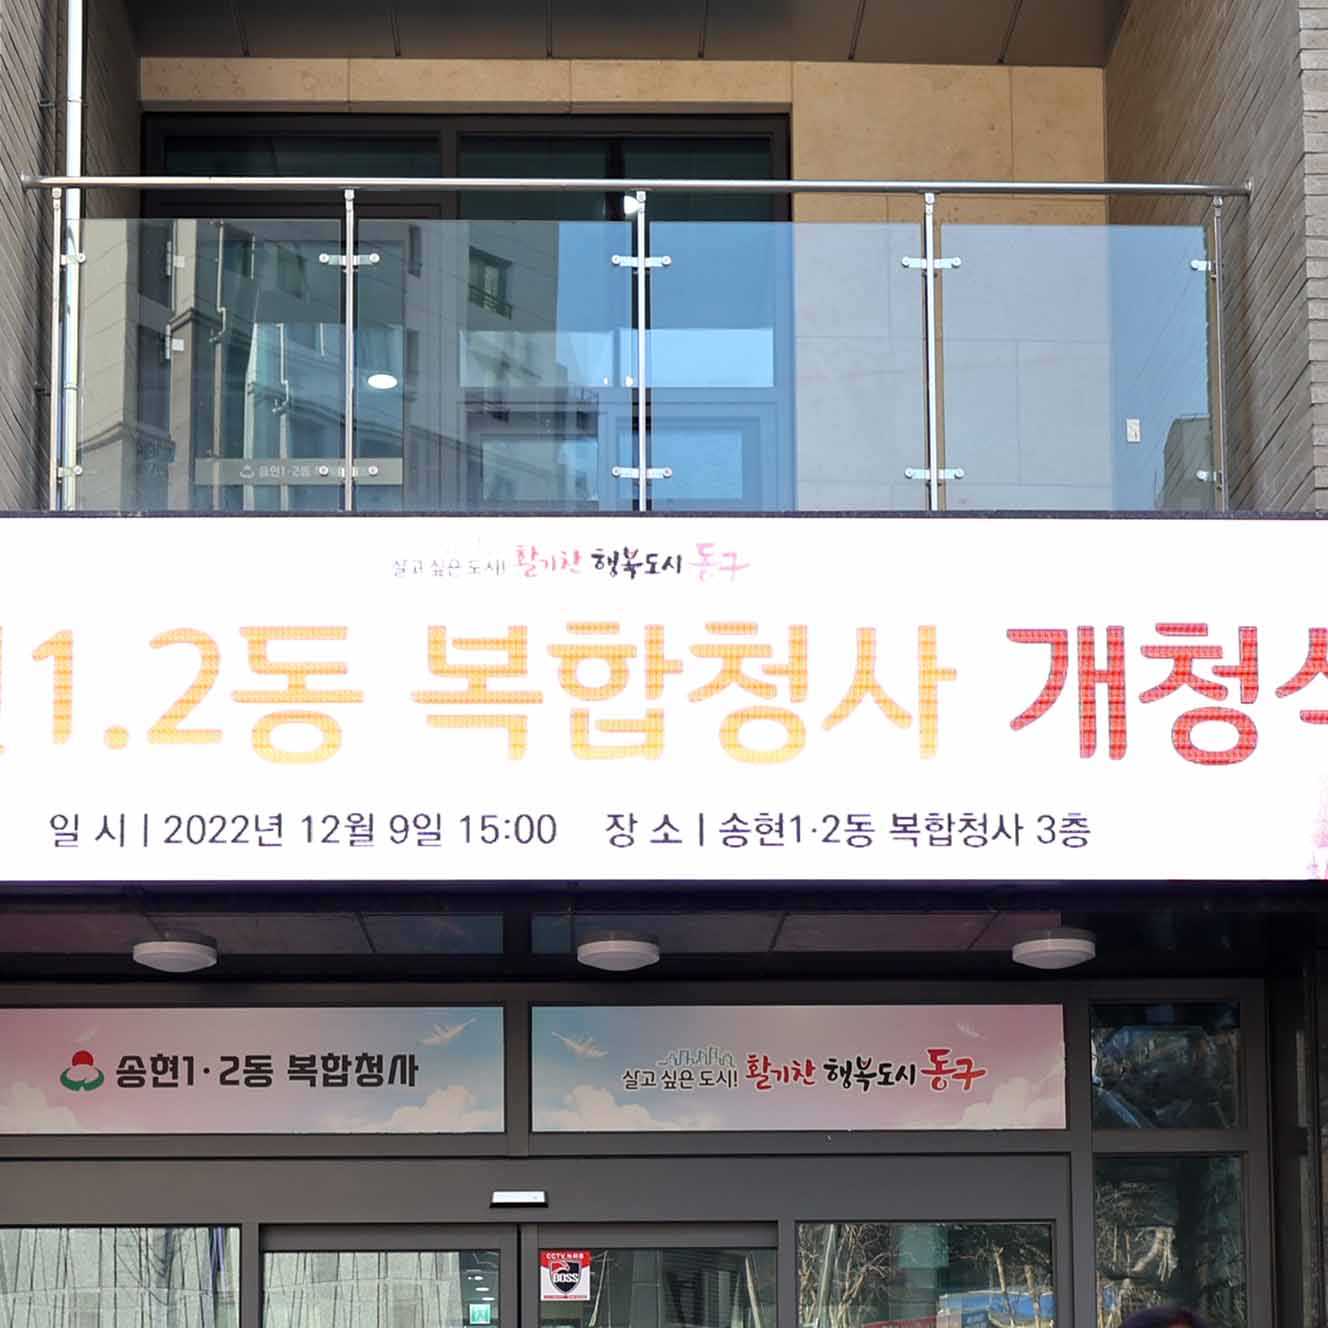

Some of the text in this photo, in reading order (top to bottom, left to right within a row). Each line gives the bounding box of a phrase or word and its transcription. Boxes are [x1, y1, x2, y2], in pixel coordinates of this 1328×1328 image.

[591, 546, 682, 580] 행복도시
[411, 620, 957, 765] 복합청사
[163, 812, 284, 848] 2022년
[302, 812, 376, 849] 12월
[389, 812, 443, 848] 9일
[458, 814, 557, 845] 15:00
[718, 812, 875, 848] 송현1·2동
[887, 812, 1024, 848] 복합청사
[1035, 812, 1092, 848] 3층
[116, 1052, 420, 1089] 송현1·2동 복합청사
[623, 1048, 987, 1093] 살고 싶은 도시! 활기찬 행복도시 동구
